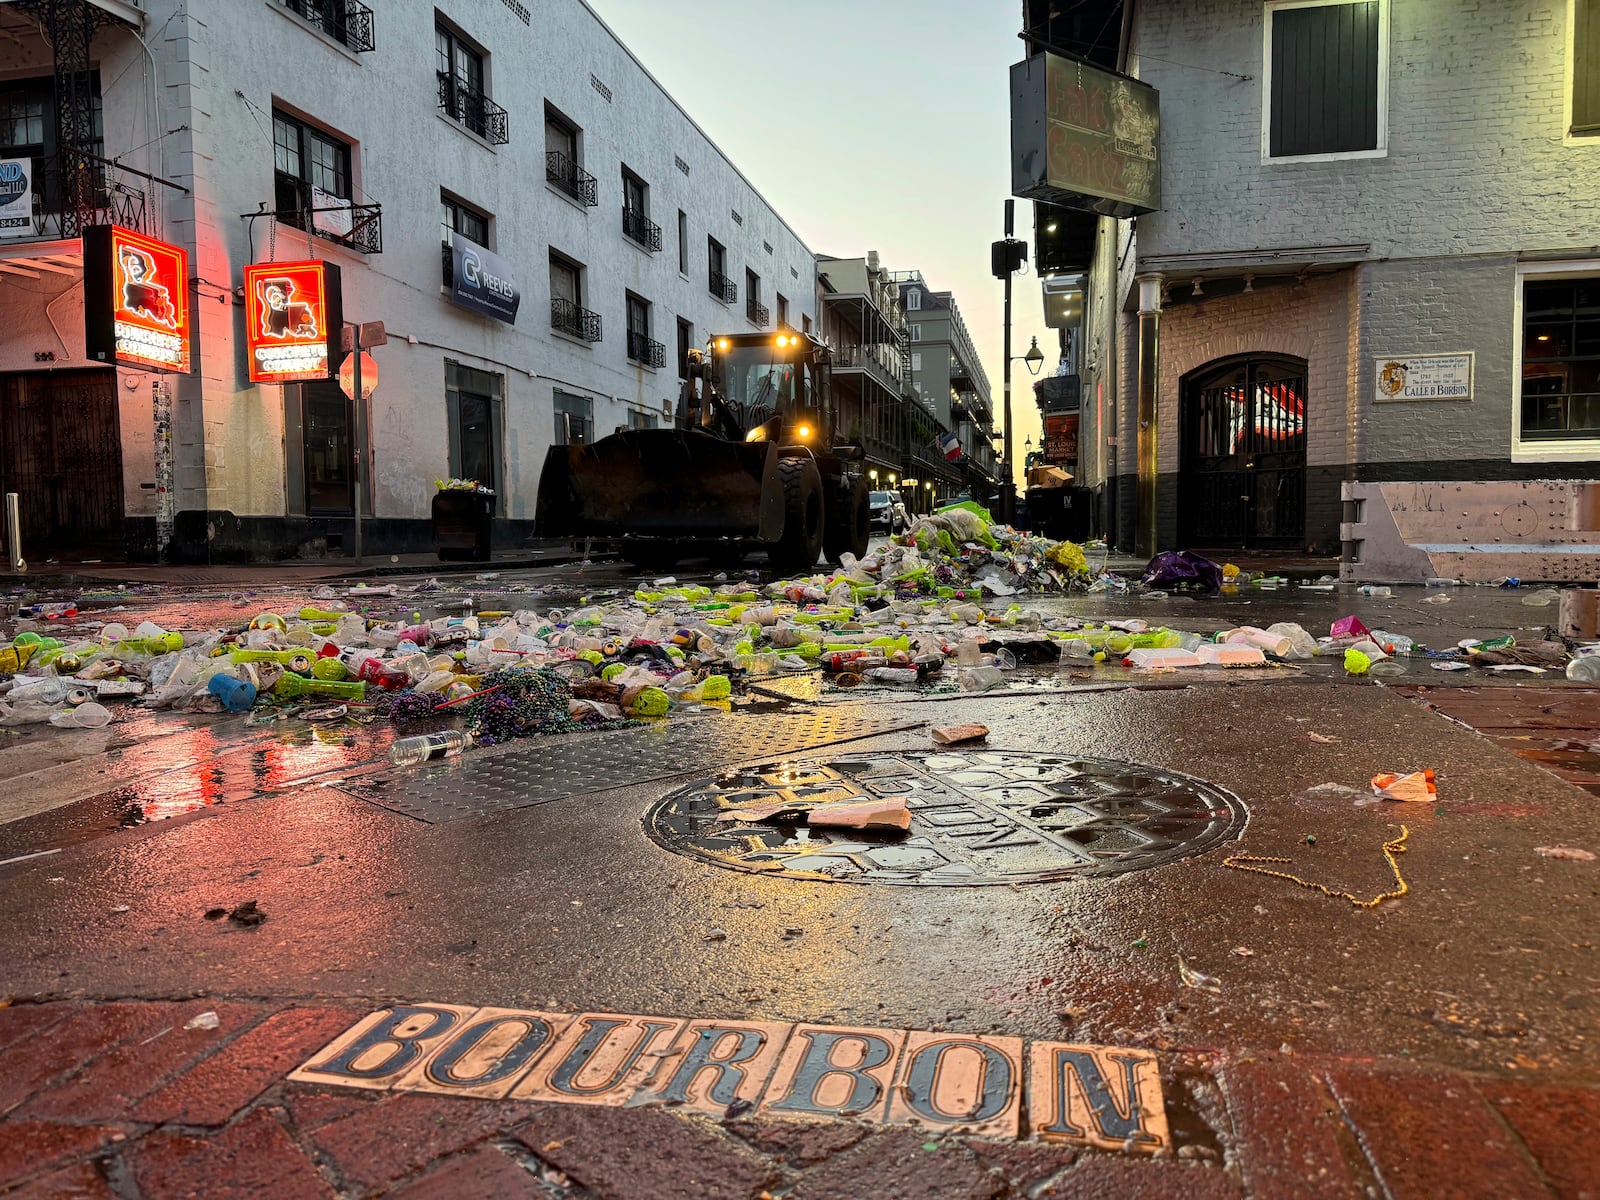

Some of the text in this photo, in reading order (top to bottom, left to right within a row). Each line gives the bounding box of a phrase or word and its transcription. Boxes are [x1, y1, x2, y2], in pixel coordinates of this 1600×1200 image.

[483, 272, 514, 298] REEVES
[1404, 386, 1429, 396] CALLE
[1438, 385, 1467, 395] BORBON
[303, 1005, 1160, 1150] BOURBON
